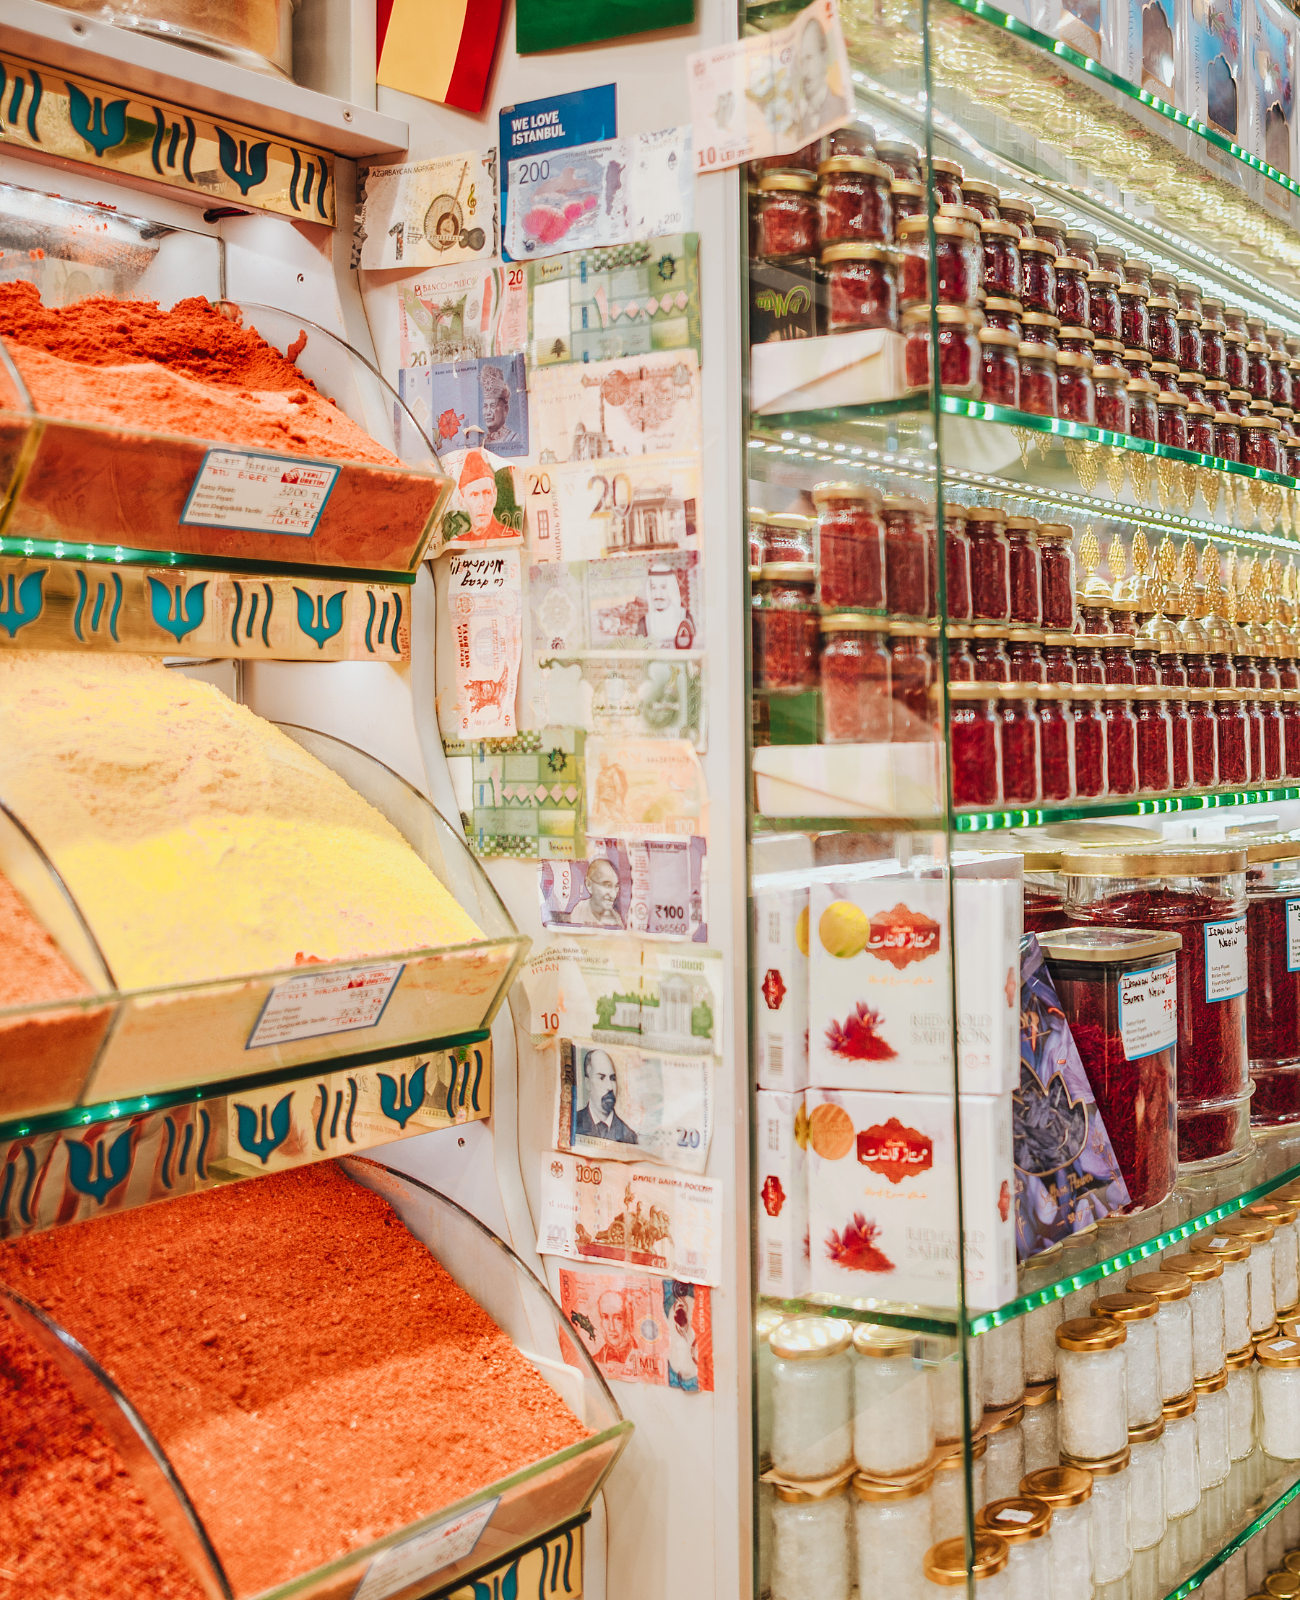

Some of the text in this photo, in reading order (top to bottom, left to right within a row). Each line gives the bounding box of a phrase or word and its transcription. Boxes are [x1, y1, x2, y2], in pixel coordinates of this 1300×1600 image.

[1256, 15, 1262, 30] 25
[512, 110, 559, 131] WE LOVE
[512, 124, 565, 146] ISTANBUL
[698, 146, 716, 167] 10
[720, 152, 735, 162] LEI
[519, 160, 550, 185] 200
[664, 213, 681, 224] 200
[388, 222, 404, 260] 1
[508, 269, 523, 286] 20
[422, 281, 448, 292] BANCO
[410, 351, 427, 368] 20
[279, 485, 307, 498] 3200
[529, 473, 551, 495] 20
[587, 473, 632, 519] 20
[501, 511, 523, 537] 20
[462, 623, 471, 669] MOLDOVA
[462, 717, 469, 729] 50
[504, 714, 511, 727] 50
[675, 818, 695, 835] 100
[655, 904, 684, 919] ₹100
[532, 963, 560, 975] IRAN
[1123, 992, 1145, 1005] SUPER
[541, 1013, 560, 1030] 10
[676, 1126, 700, 1148] 20
[576, 1165, 602, 1185] 100
[685, 1182, 713, 1193] РОССИИ
[906, 1226, 937, 1242] RED
[640, 1358, 659, 1370] MIL
